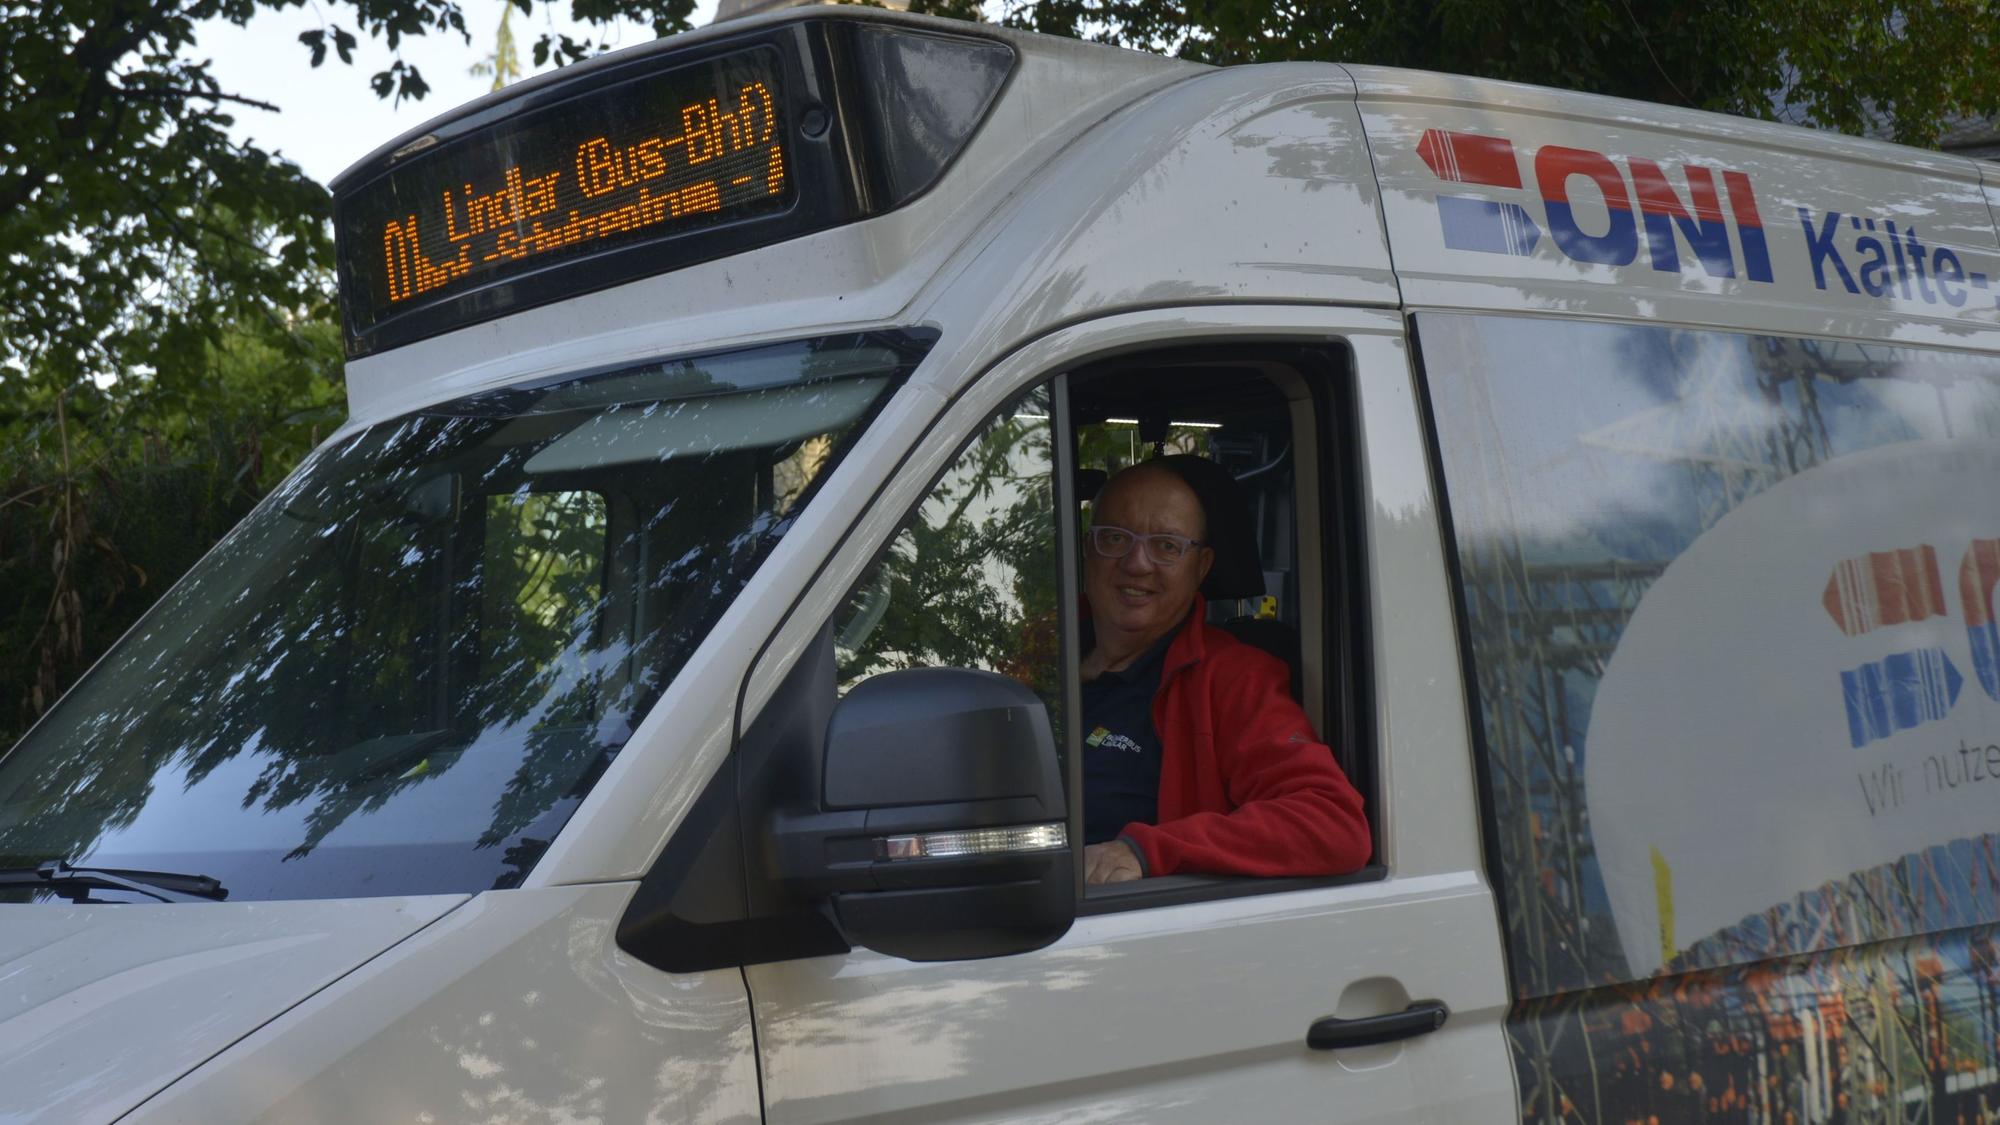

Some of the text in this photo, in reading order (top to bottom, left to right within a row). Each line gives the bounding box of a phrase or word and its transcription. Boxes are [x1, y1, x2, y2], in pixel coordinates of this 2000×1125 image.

[576, 82, 774, 198] (Bus-Bhf)
[1535, 144, 1774, 283] ONI
[1858, 762, 1905, 816] Wir
